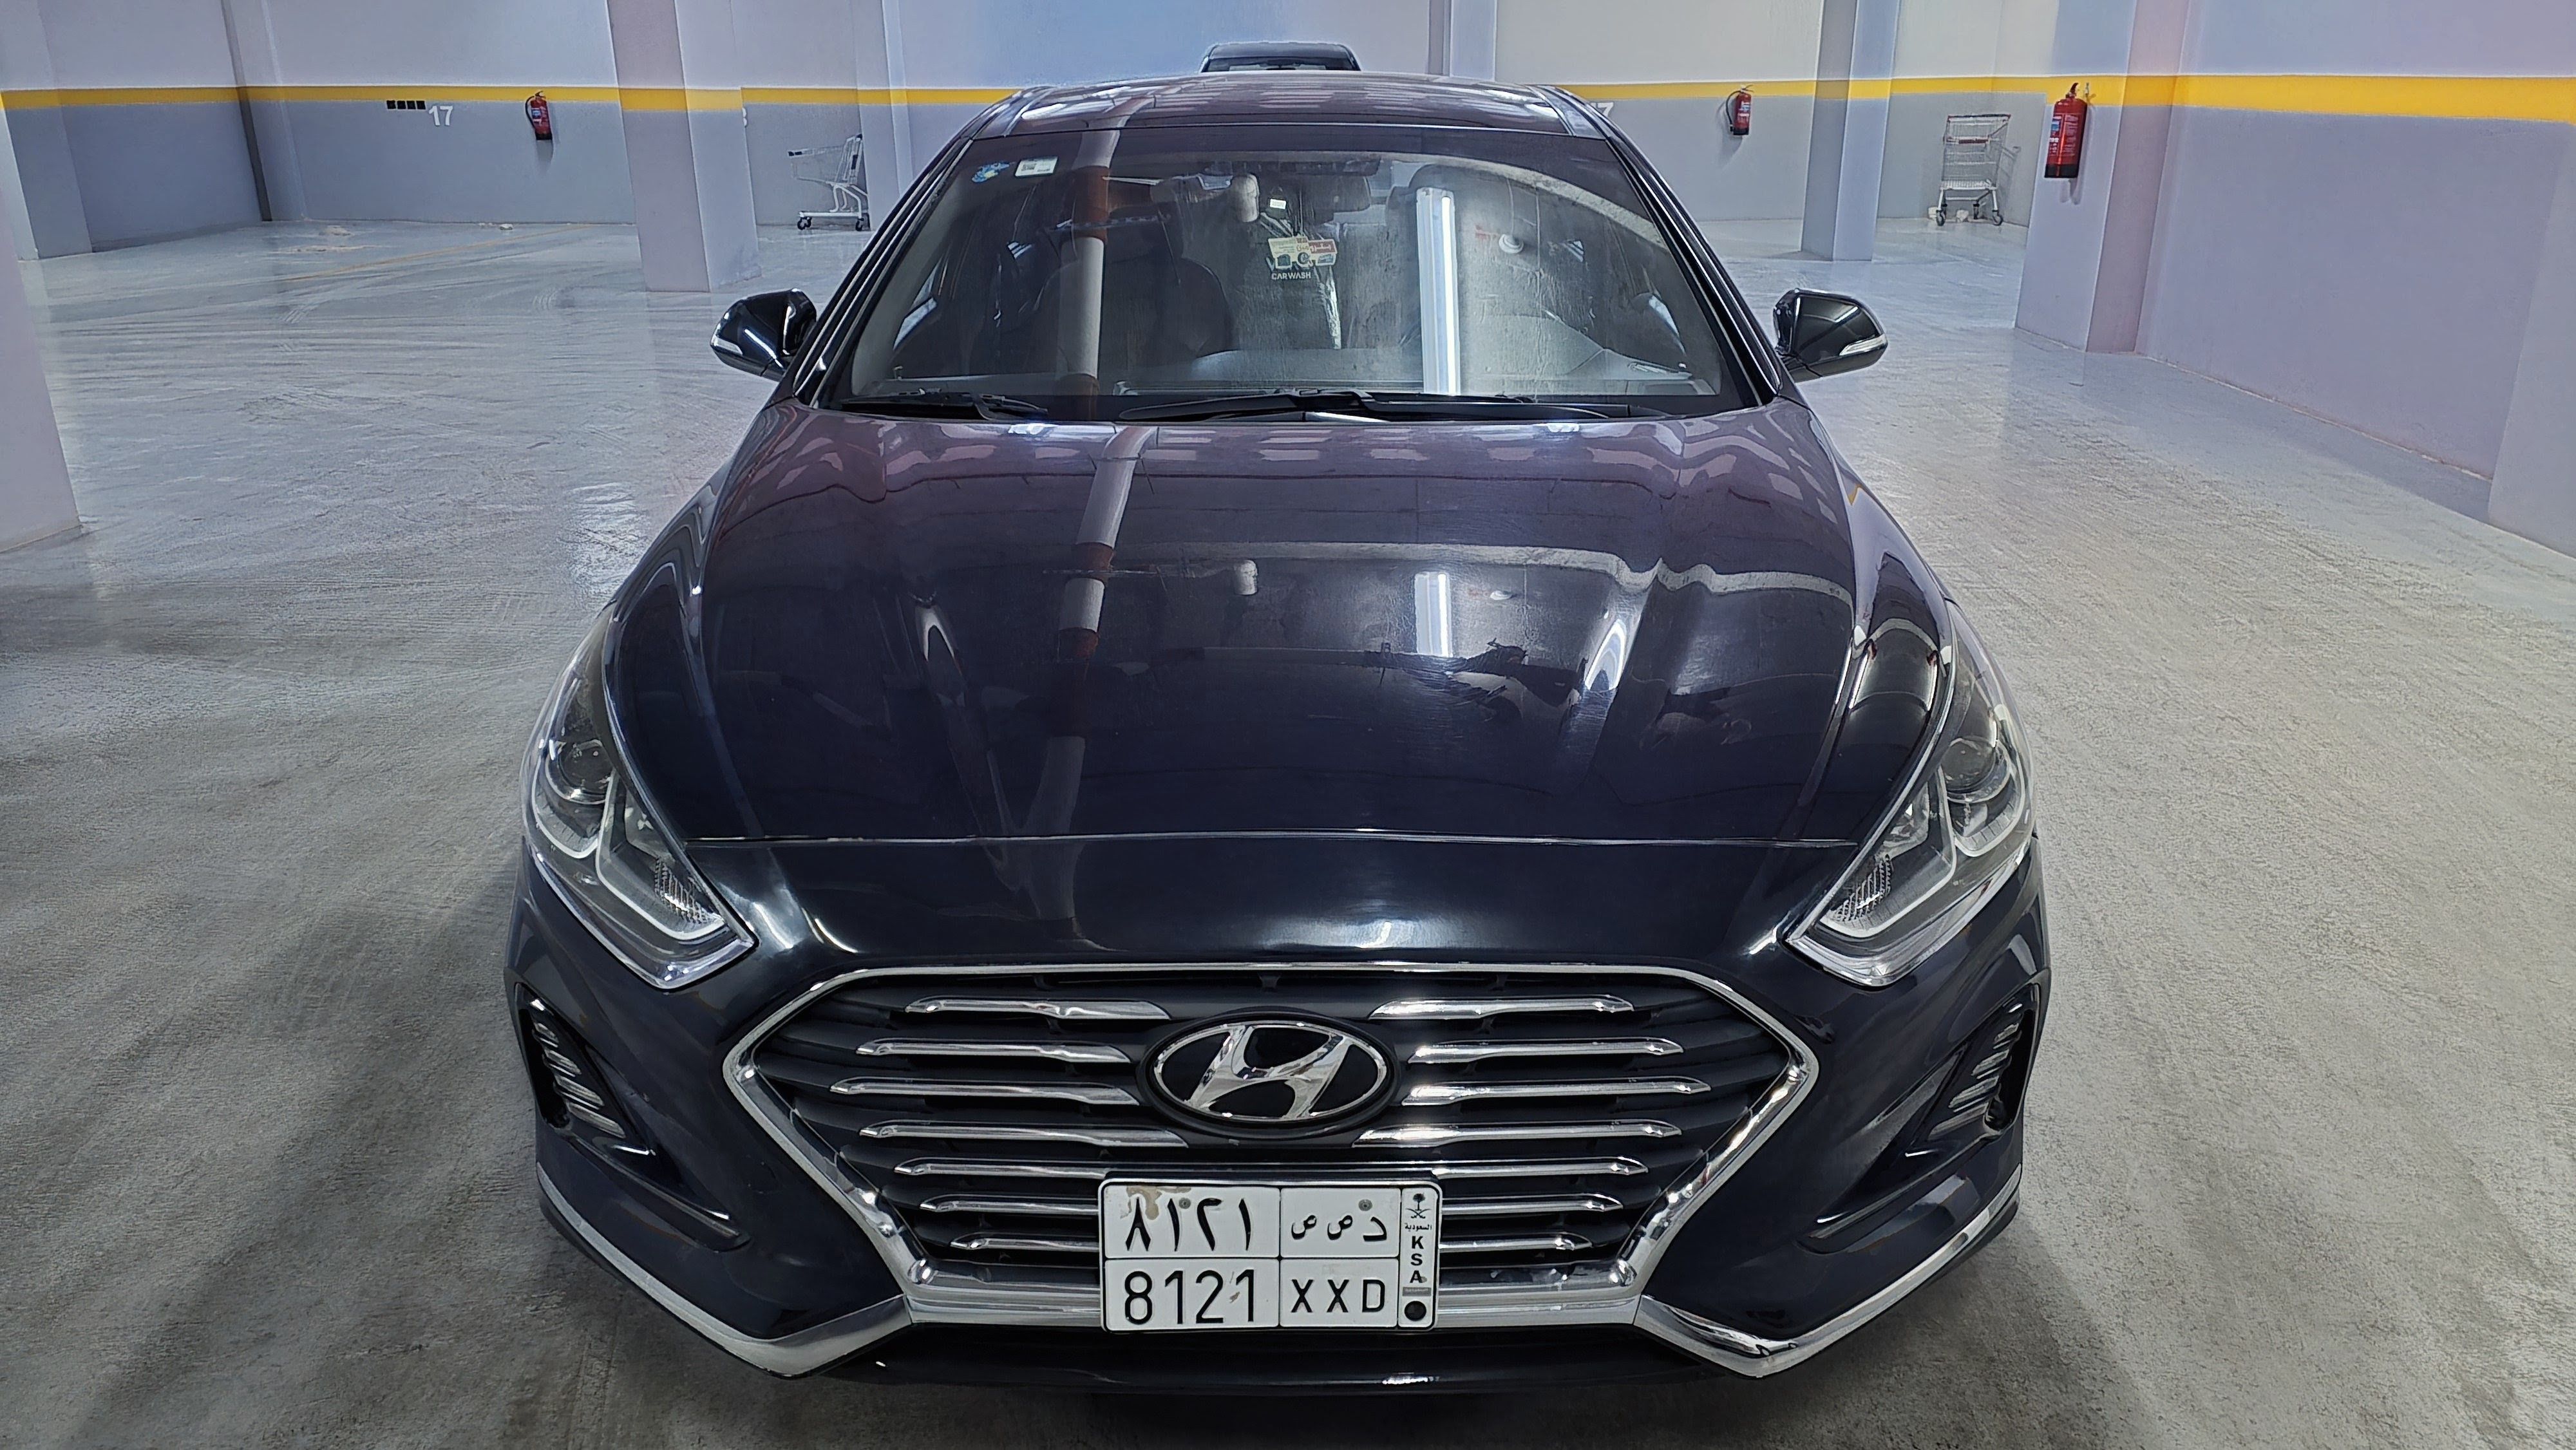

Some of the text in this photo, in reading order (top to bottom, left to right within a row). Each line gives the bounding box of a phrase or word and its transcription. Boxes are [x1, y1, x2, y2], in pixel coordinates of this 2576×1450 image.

[428, 105, 453, 126] 17
[1404, 1223, 1432, 1232] السعودية
[1124, 1269, 1255, 1324] 8121
